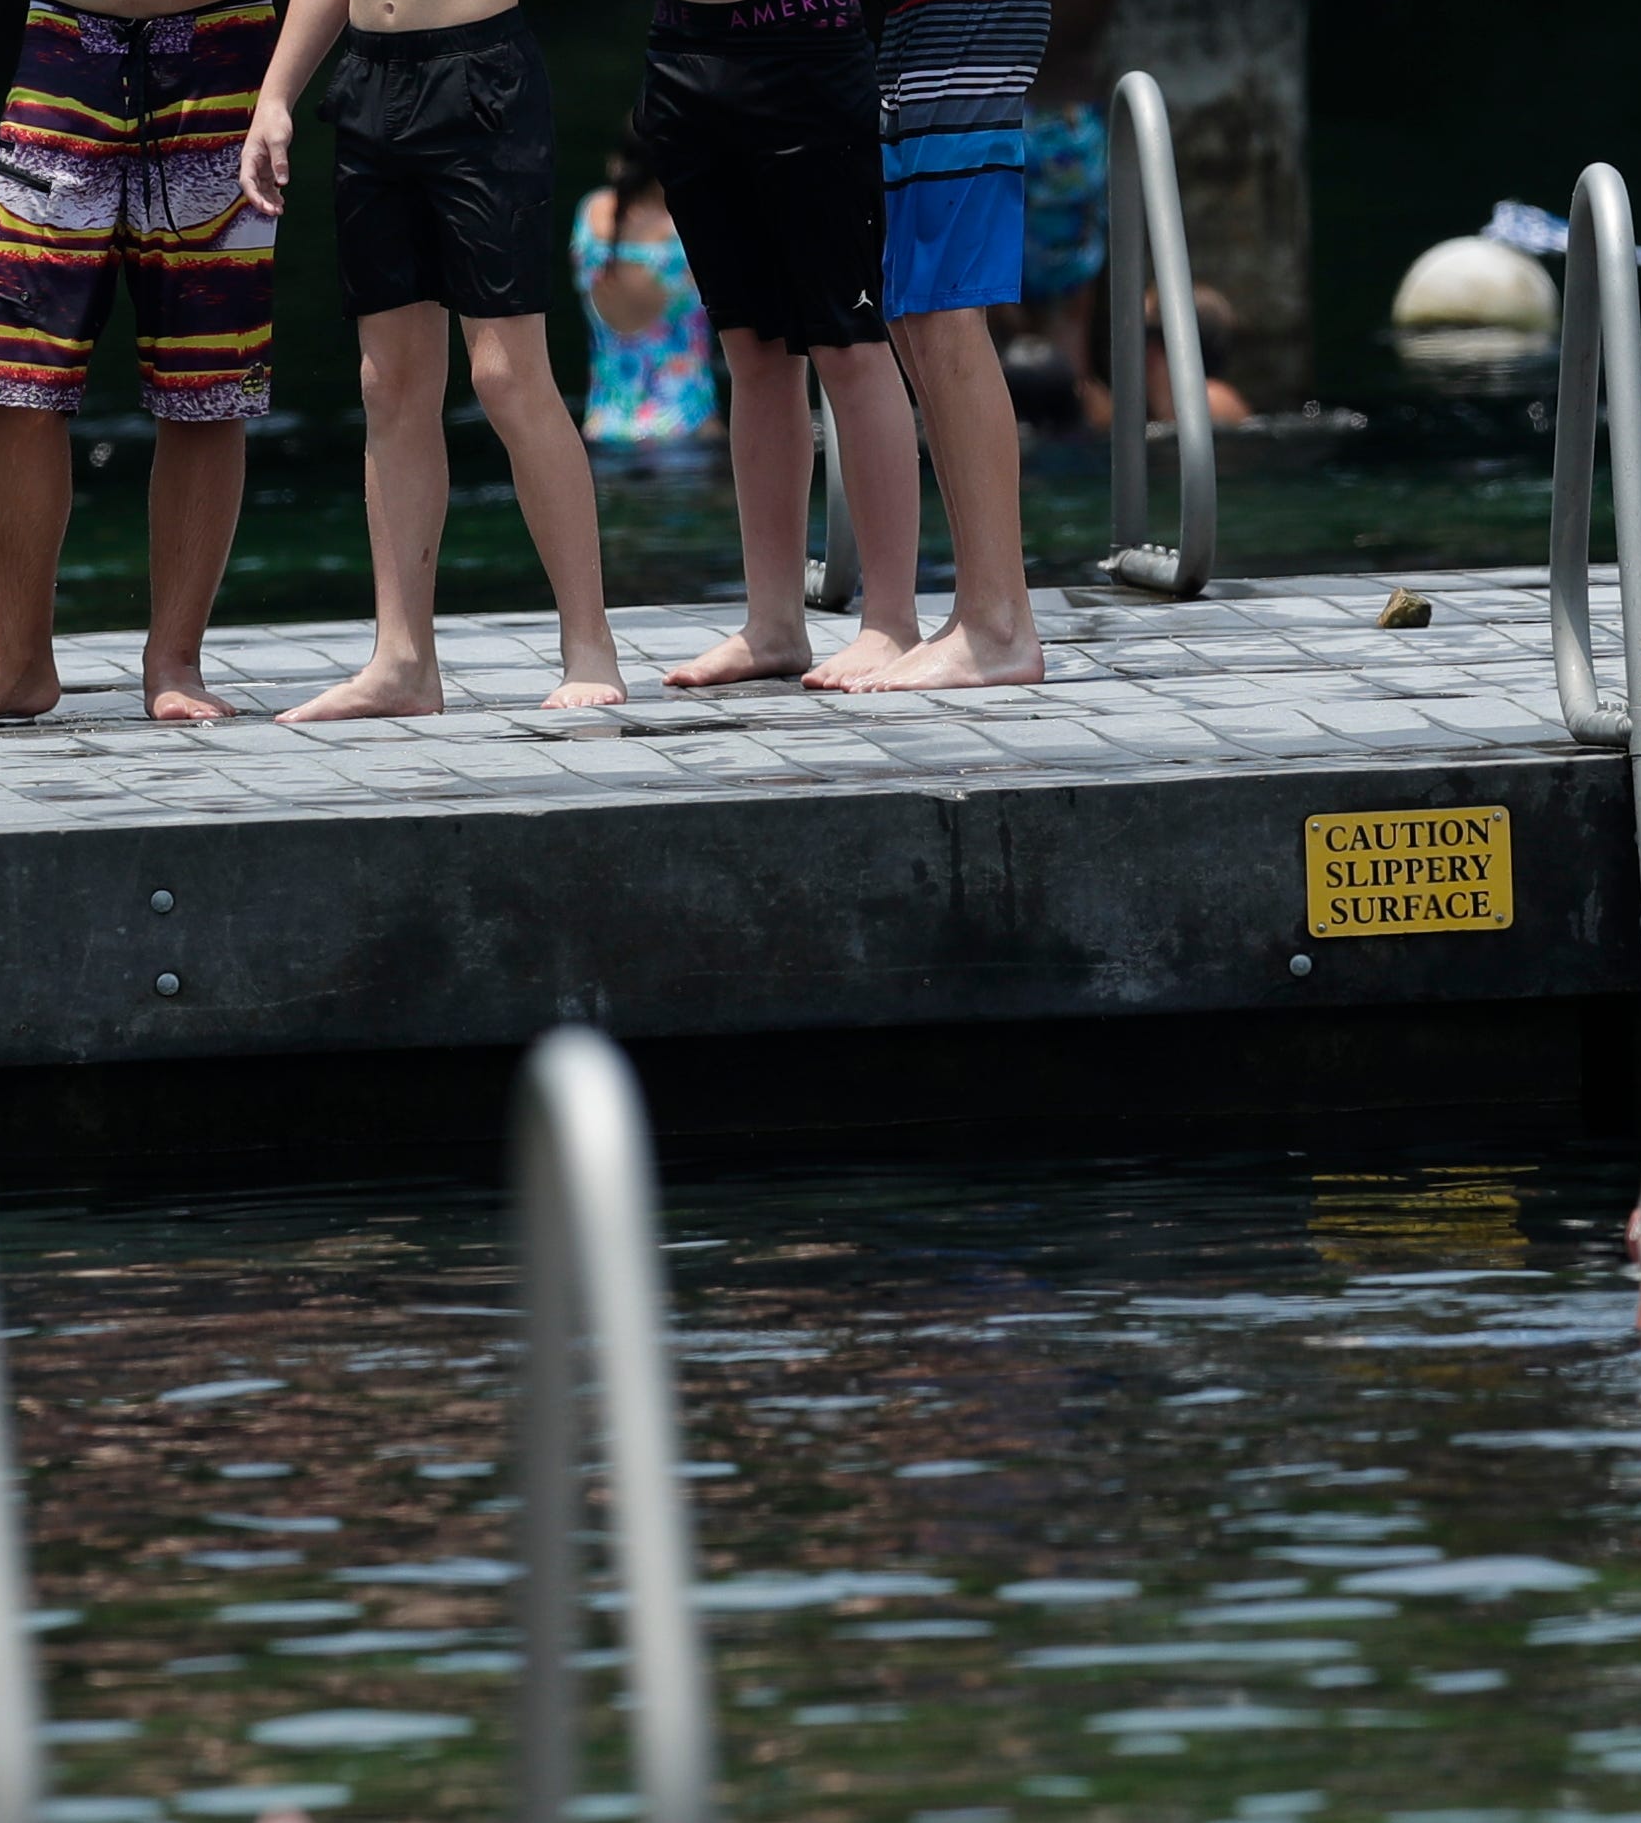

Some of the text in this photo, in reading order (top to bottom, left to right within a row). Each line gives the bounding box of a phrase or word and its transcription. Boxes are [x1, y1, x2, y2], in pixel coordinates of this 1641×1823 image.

[1325, 818, 1491, 853] CAUTION
[1326, 854, 1493, 889] SLIPPERY
[1330, 891, 1492, 925] SURFACE
